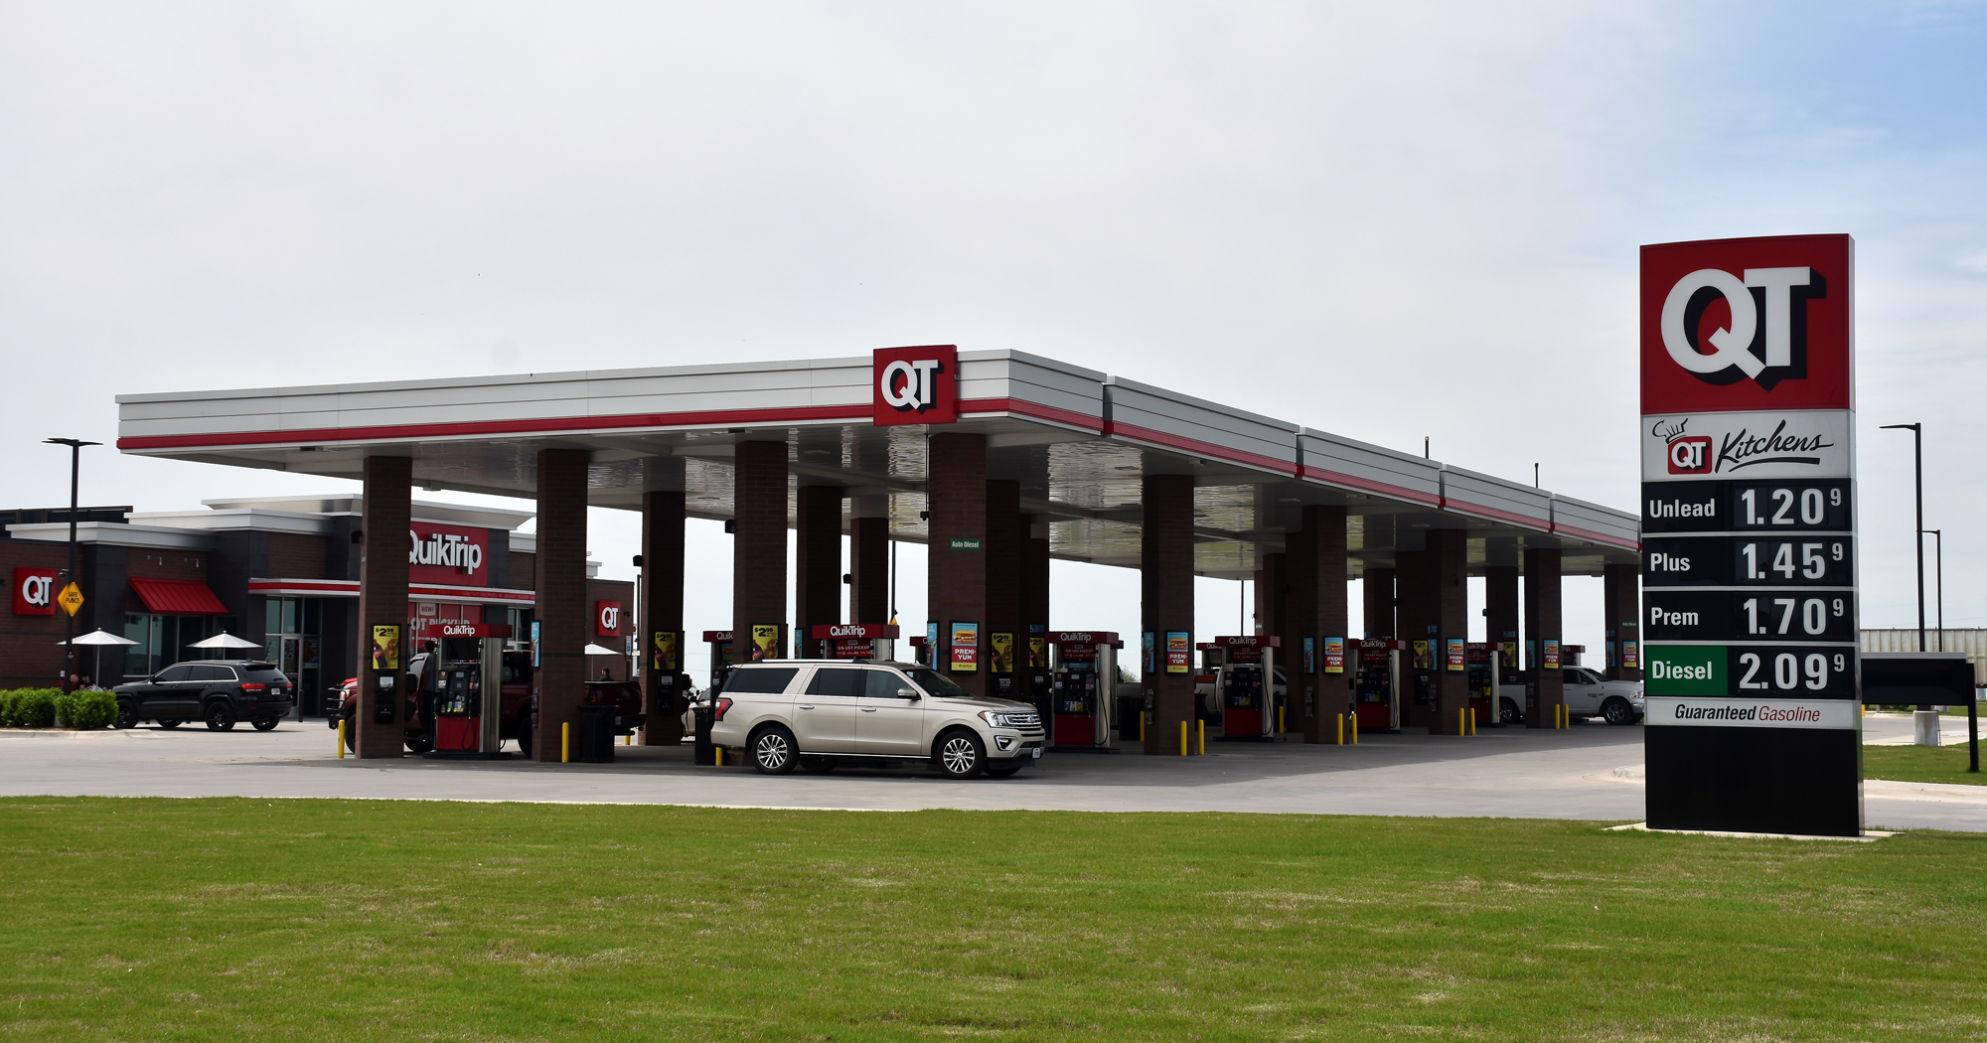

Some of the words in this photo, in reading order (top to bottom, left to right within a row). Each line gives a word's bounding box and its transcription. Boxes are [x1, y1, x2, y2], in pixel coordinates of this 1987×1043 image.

[1660, 266, 1812, 380] QT
[881, 360, 938, 410] QT
[1670, 441, 1706, 469] QT
[1714, 419, 1835, 473] Kitchens
[1649, 498, 1715, 519] Unlead
[1650, 553, 1691, 573] Plus
[22, 575, 53, 607] QT
[602, 607, 618, 630] QT
[1650, 607, 1699, 627] Prem
[443, 625, 476, 637] QuikTrip
[716, 632, 734, 641] Quik
[830, 626, 866, 638] QuikTrip
[1060, 632, 1092, 643] QuikTrip
[1228, 637, 1257, 647] QuikTrip
[1360, 640, 1387, 648] QuikTrip
[1651, 660, 1713, 681] Diesel
[1674, 703, 1757, 721] Guaranteed
[1758, 705, 1821, 722] Gasoline
